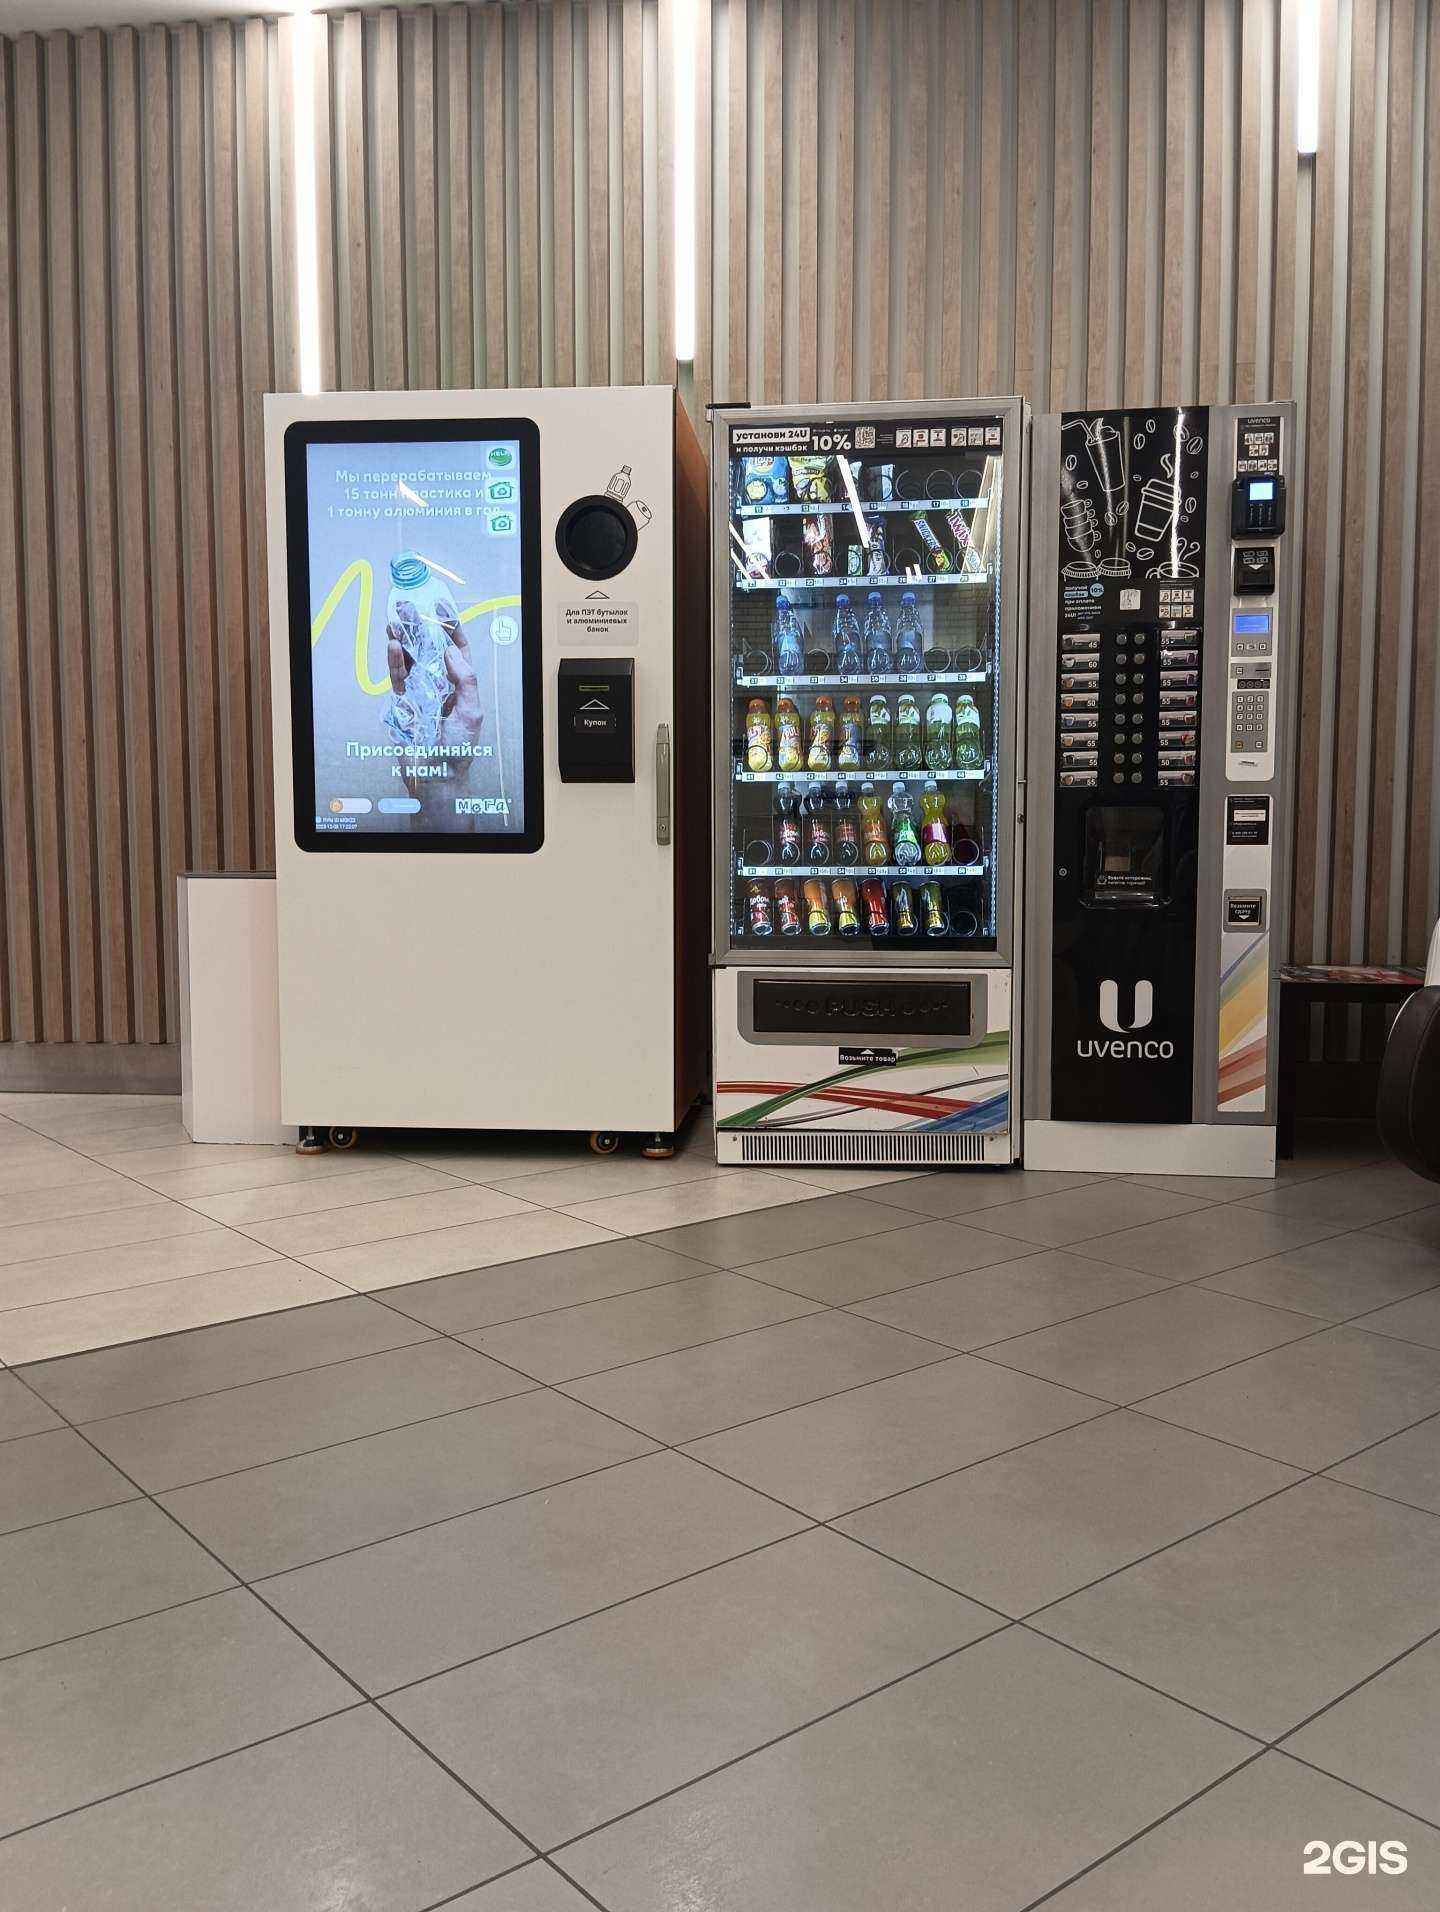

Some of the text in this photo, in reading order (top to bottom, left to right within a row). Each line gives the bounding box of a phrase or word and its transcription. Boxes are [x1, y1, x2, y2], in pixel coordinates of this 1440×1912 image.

[736, 430, 786, 442] установи
[788, 430, 807, 439] 24U
[811, 434, 852, 451] 10%
[743, 445, 774, 454] получи
[775, 444, 808, 452] кэшбэк
[335, 469, 492, 484] Мы перерабатываем
[344, 488, 360, 500] 15
[363, 489, 398, 500] тонн
[474, 488, 485, 498] и
[327, 505, 334, 518] 1
[336, 508, 381, 520] тонну
[384, 506, 462, 518] алюминия
[464, 507, 473, 516] в
[565, 609, 580, 617] Для
[597, 608, 629, 618] бутылок
[583, 719, 607, 728] Купон
[345, 741, 494, 760] Присоединяйся
[391, 761, 448, 777] к нам!
[1077, 1040, 1174, 1059] uvenco
[839, 1054, 896, 1063] Возьмите товар
